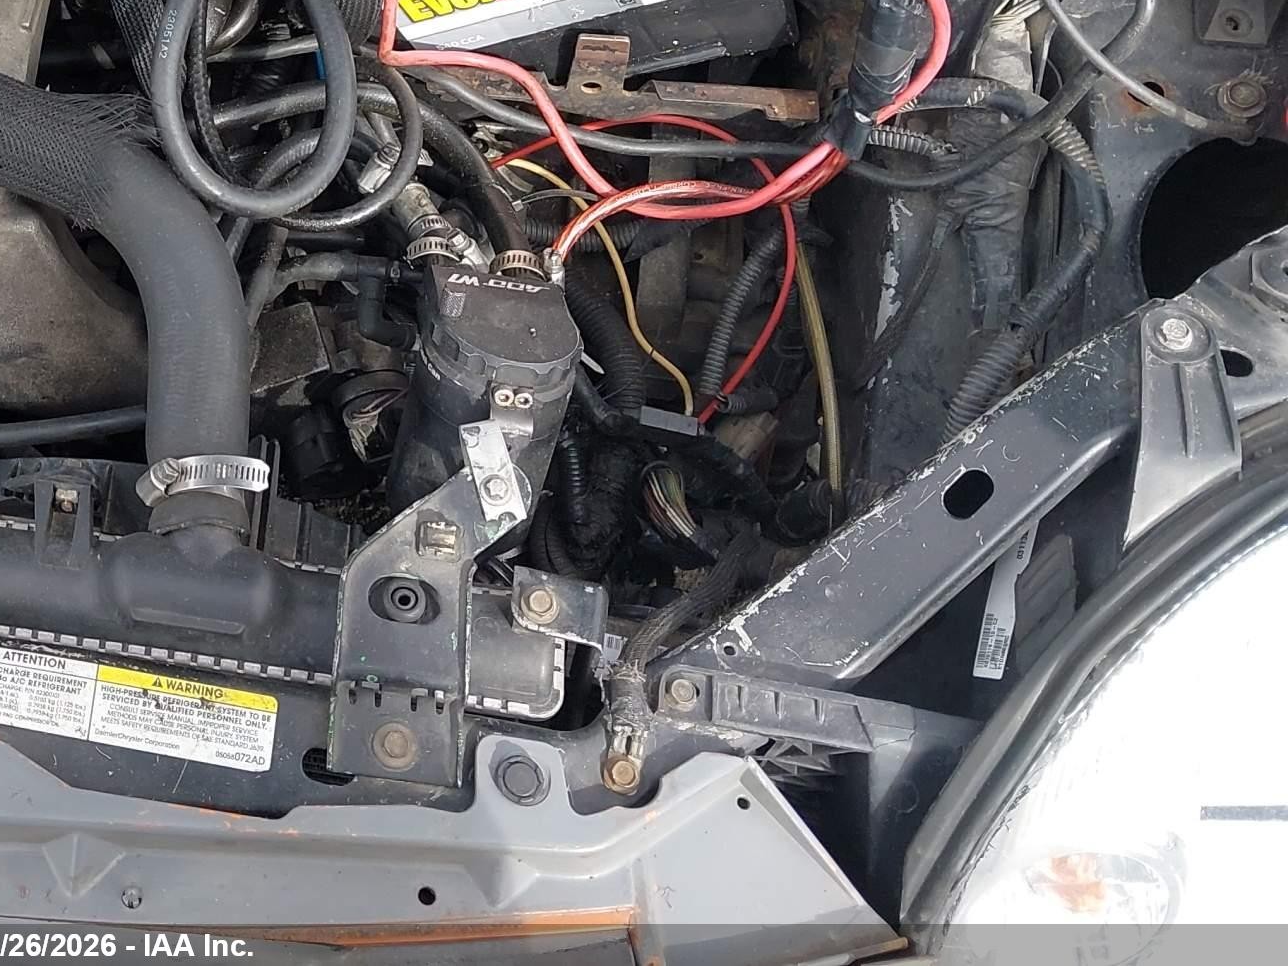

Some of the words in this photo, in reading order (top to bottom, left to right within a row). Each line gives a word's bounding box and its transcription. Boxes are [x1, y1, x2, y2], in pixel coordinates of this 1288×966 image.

[158, 9, 178, 59] 23051A2
[460, 34, 486, 45] CCA
[2, 650, 67, 670] ATTENTION
[9, 675, 26, 686] A/C
[27, 678, 82, 695] REFRIGERANT
[32, 670, 88, 689] REQUIREMENT
[166, 679, 224, 699] WARNING
[102, 693, 140, 706] SERVICED
[142, 699, 153, 708] BY
[196, 710, 243, 723] PERSONNEL
[244, 719, 269, 731] ONLY.
[109, 703, 139, 714] CONSULT
[140, 708, 166, 719] SERVICE
[197, 719, 231, 731] IMPROPER
[231, 725, 259, 736] SERVICE
[162, 696, 216, 712] REFRIGERANT
[217, 706, 247, 718] SYSTEM
[249, 712, 260, 720] TO
[261, 714, 272, 723] BE
[94, 728, 144, 743] DaimlerChrysler
[144, 737, 181, 751] Corporation
[107, 710, 137, 721] METHODS
[138, 715, 153, 724] MAY
[176, 722, 209, 734] PERSONAL
[235, 734, 259, 744] SYSTEM
[121, 719, 143, 730] SAFETY
[143, 722, 191, 739] REQUIREMENTS
[214, 737, 249, 749] STANDARD
